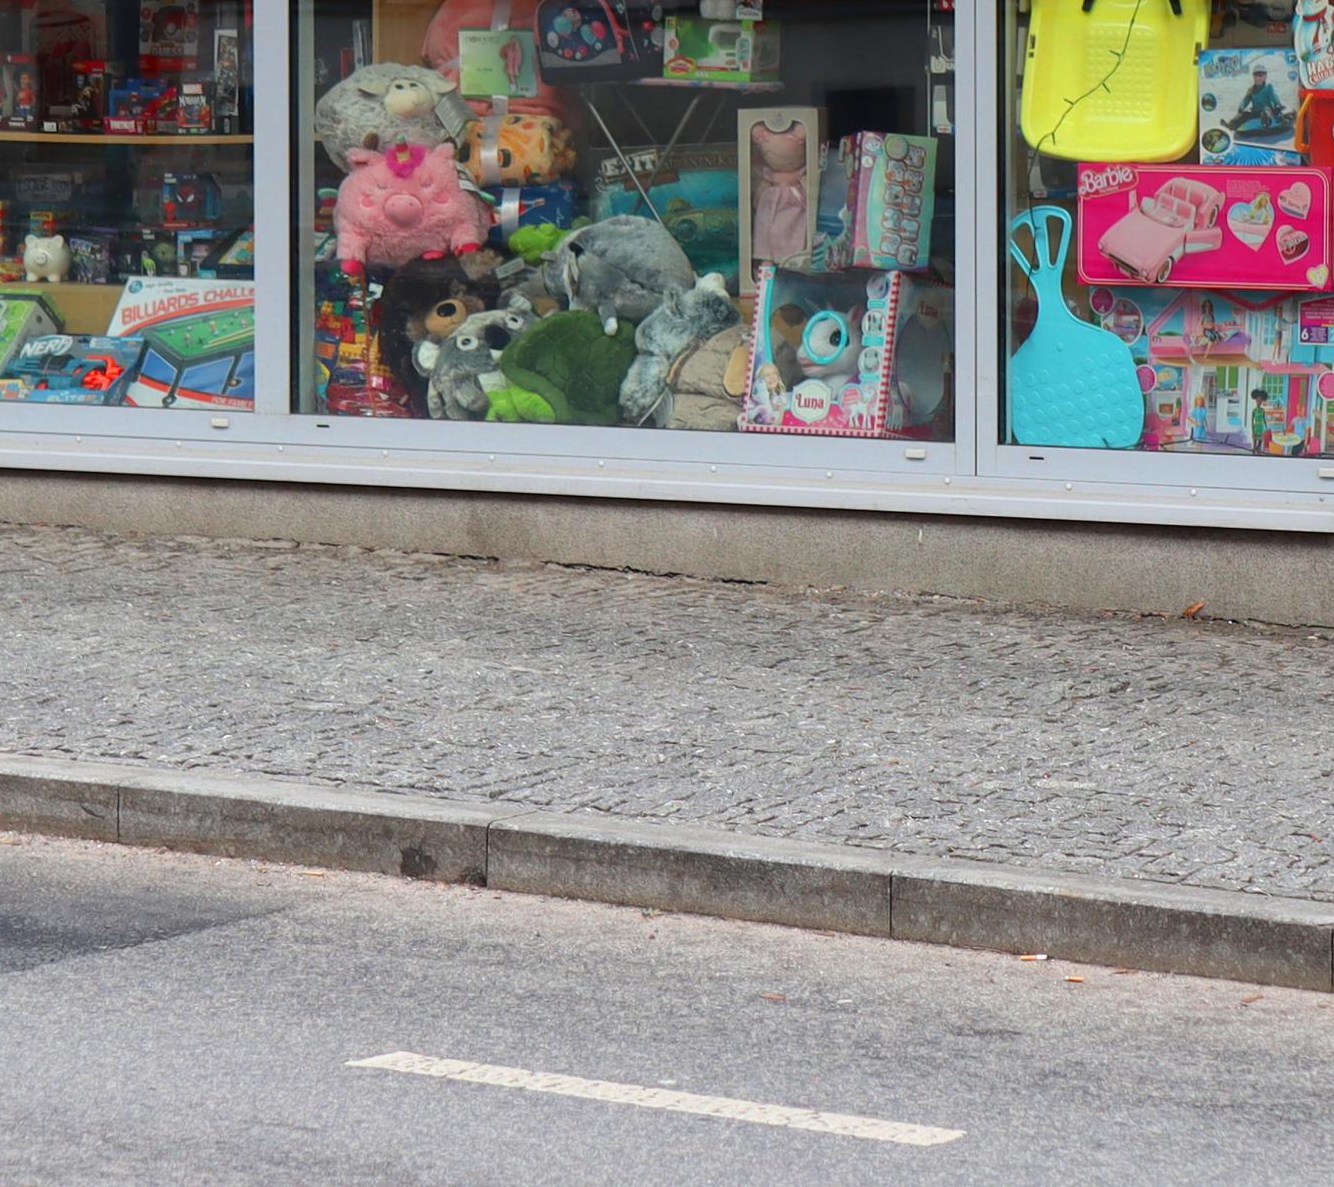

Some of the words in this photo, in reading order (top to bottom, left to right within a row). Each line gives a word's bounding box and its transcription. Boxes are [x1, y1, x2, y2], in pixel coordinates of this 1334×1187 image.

[1079, 166, 1135, 195] Barbie
[121, 292, 199, 326] BILLIARDS
[19, 334, 74, 359] NERF
[1301, 328, 1309, 340] 6
[794, 391, 825, 411] Luna
